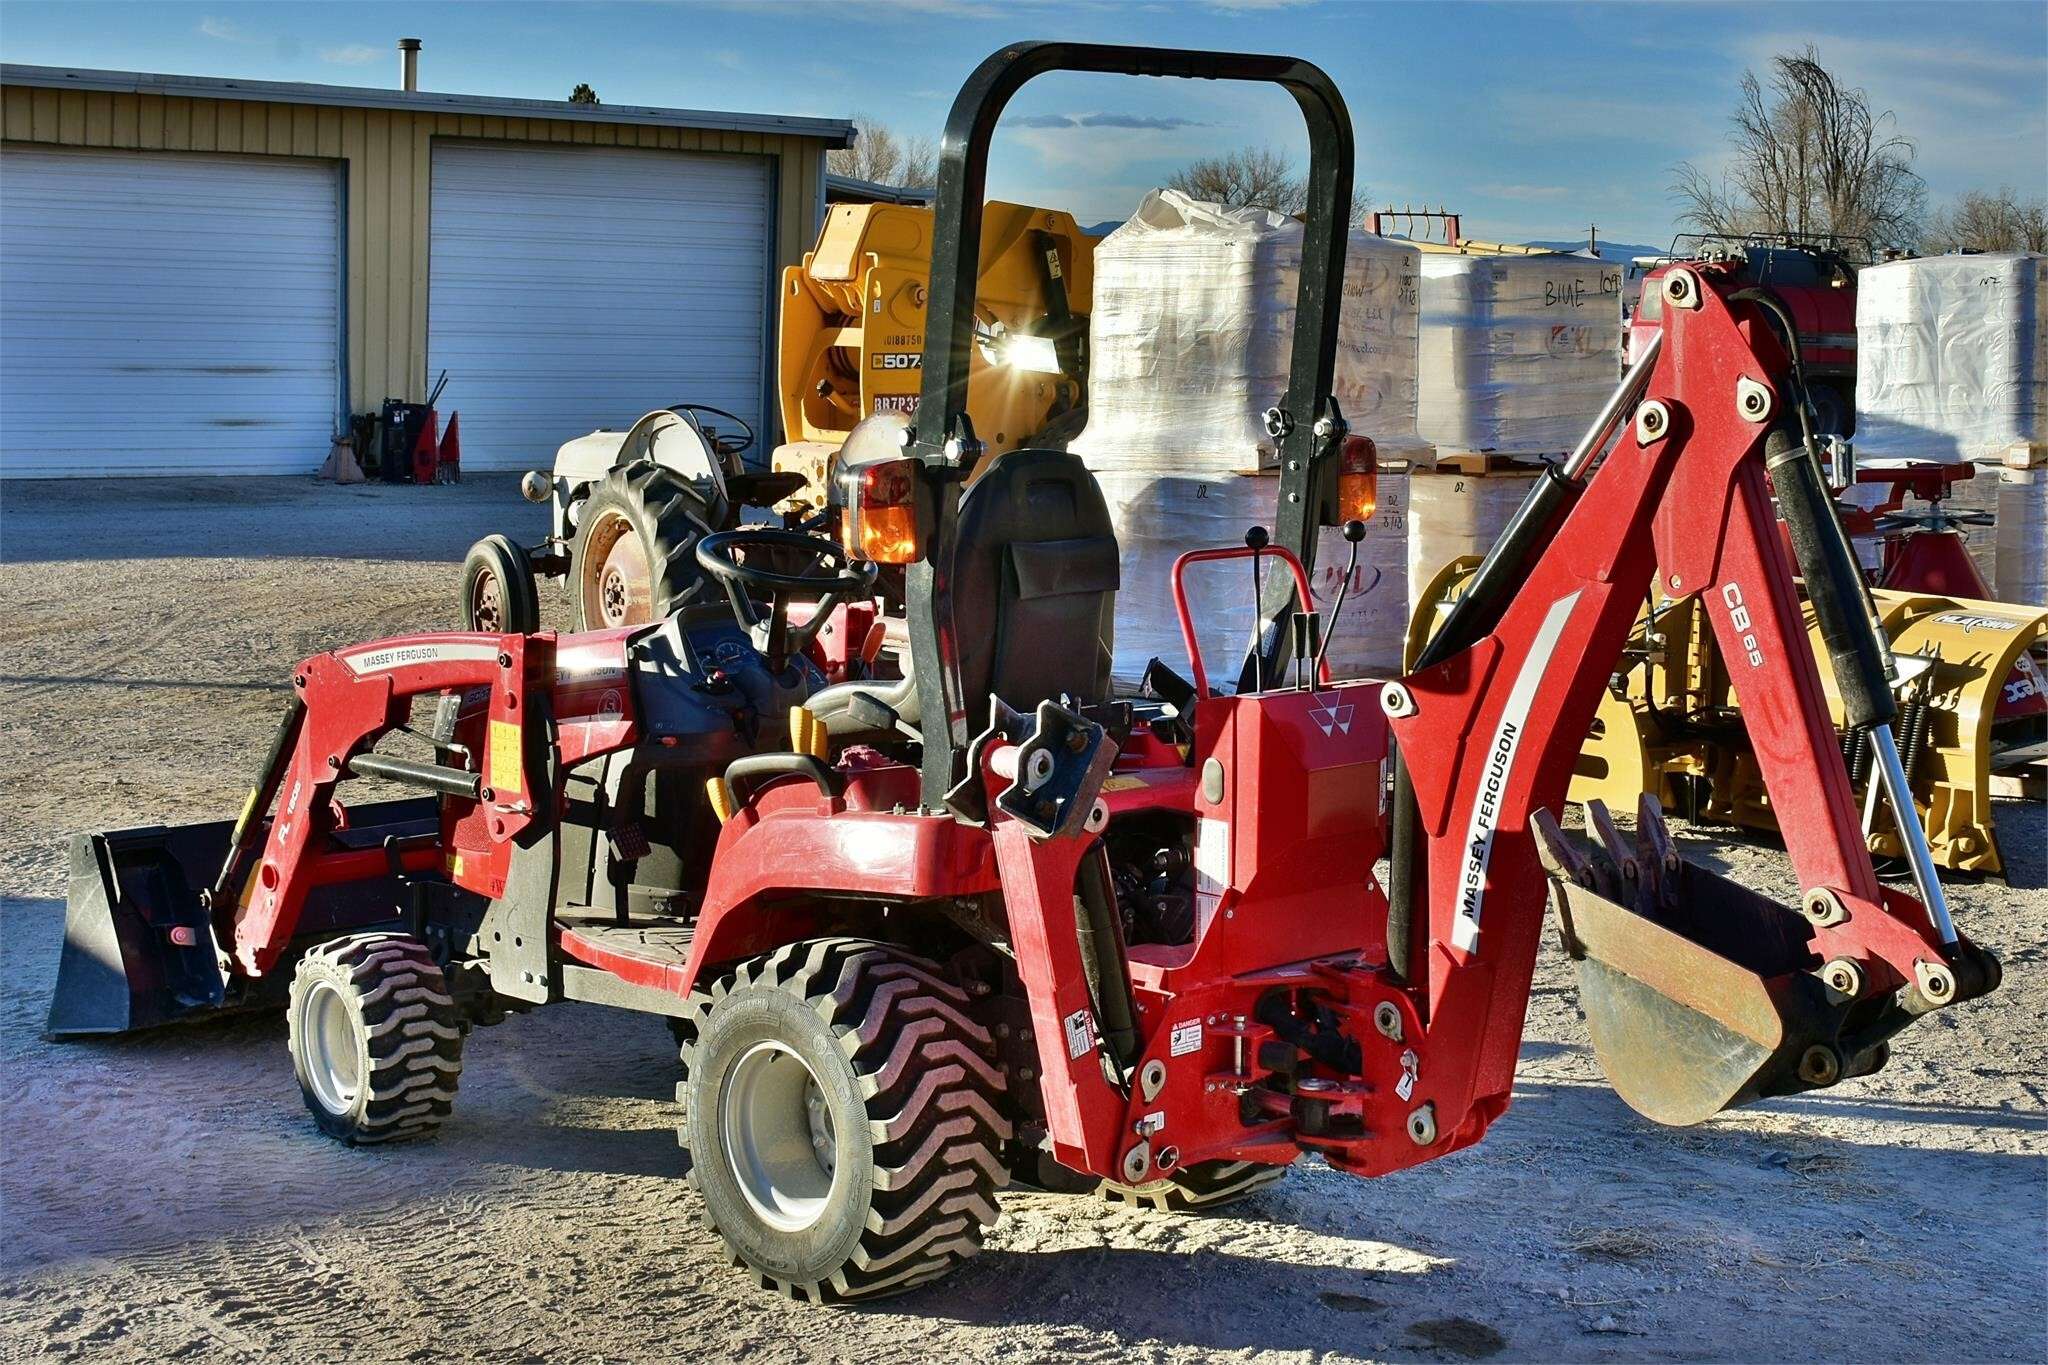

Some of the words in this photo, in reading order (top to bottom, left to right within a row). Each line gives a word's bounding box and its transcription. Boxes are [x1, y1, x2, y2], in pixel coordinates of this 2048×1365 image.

[363, 655, 395, 668] MASSEY
[396, 648, 438, 662] FERGUSON
[1722, 581, 1753, 633] CB
[1743, 634, 1763, 668] 65
[1461, 833, 1487, 919] MASSEY
[1477, 722, 1518, 830] FERGUSON
